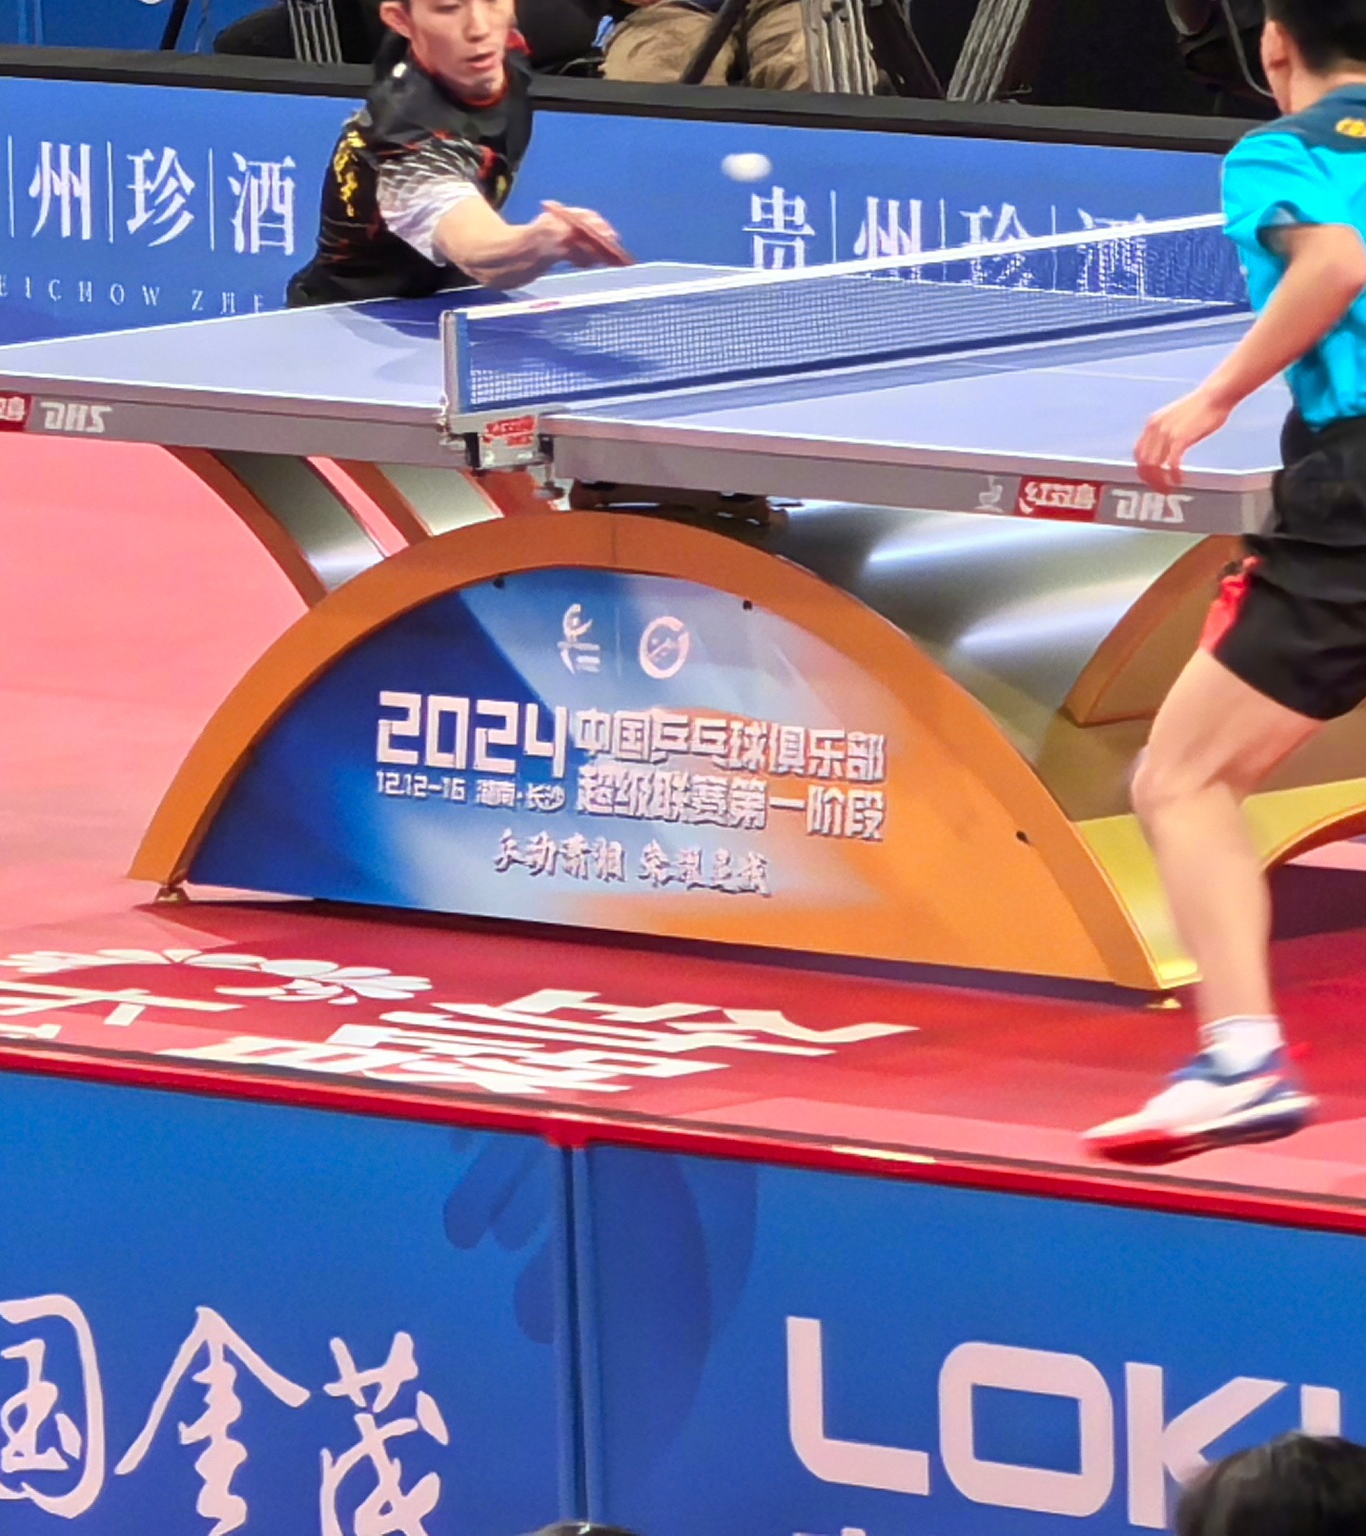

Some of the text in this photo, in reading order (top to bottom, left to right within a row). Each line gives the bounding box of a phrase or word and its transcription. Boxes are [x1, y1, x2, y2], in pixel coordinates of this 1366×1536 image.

[191, 289, 267, 316] ZHE
[40, 401, 113, 434] DHS
[1111, 488, 1195, 524] DHS
[376, 691, 569, 779] 2024
[575, 707, 886, 782] 中国乒乓球俱乐部
[575, 764, 885, 842] 超级联赛第一阶段
